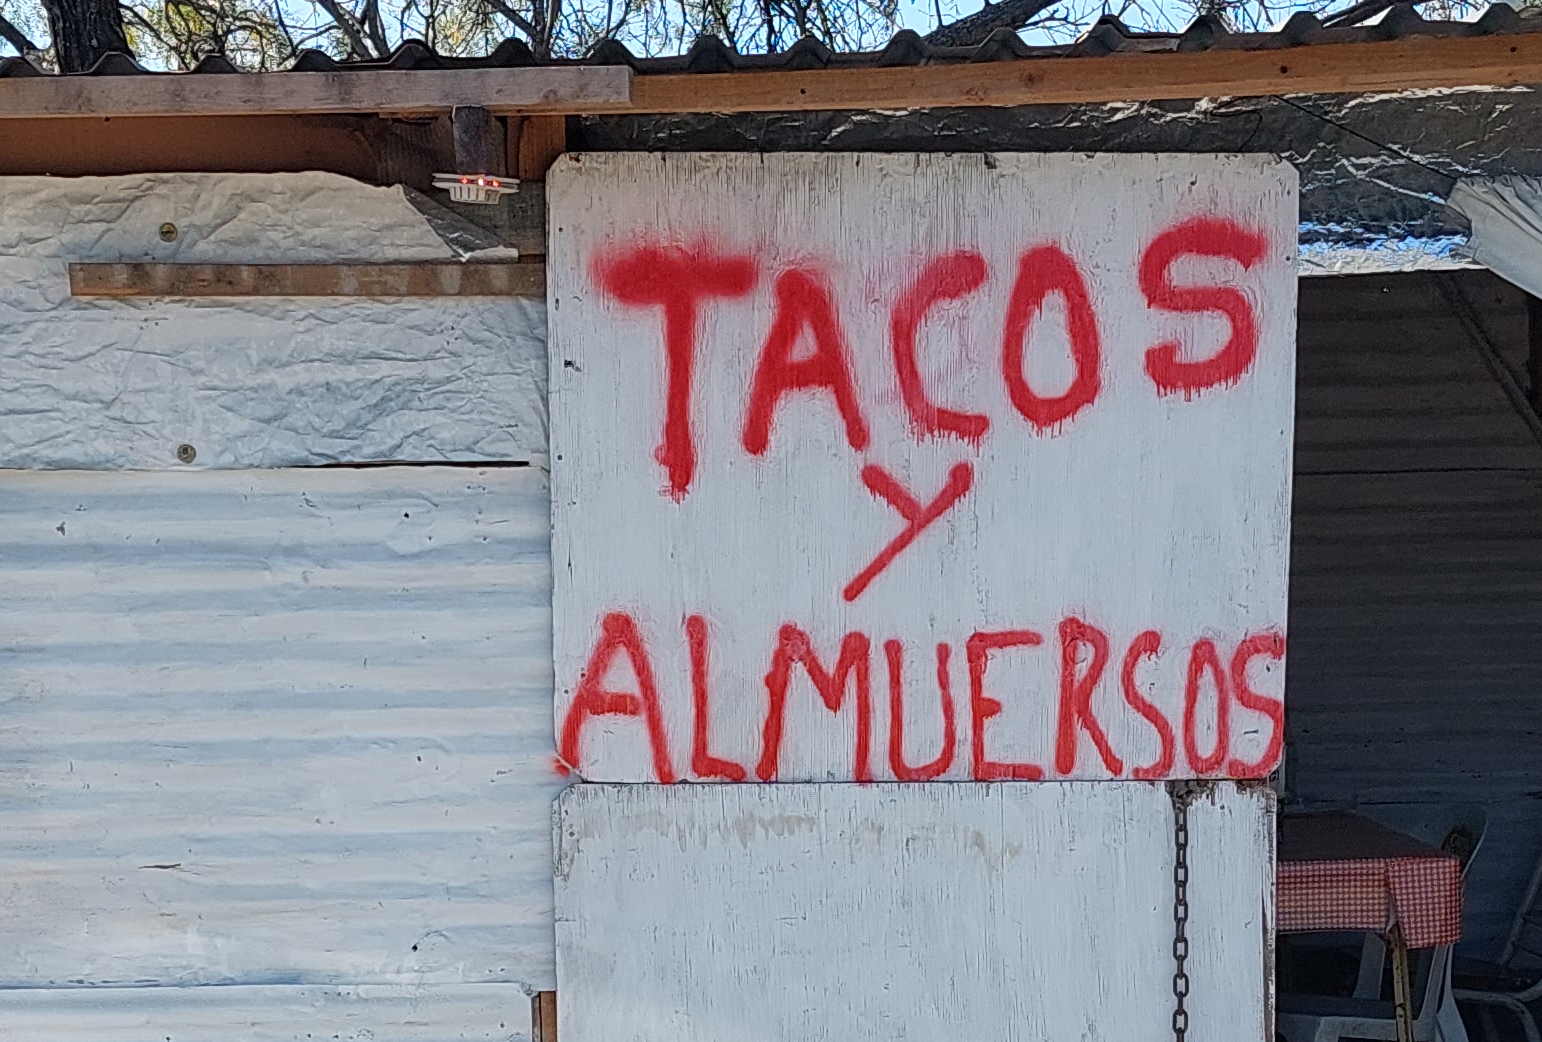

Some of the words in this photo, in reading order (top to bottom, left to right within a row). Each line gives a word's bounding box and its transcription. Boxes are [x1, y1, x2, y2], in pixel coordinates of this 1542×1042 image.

[595, 216, 1266, 499] TACOS
[842, 462, 973, 602] Y
[554, 612, 1286, 785] ALMUERSOS
